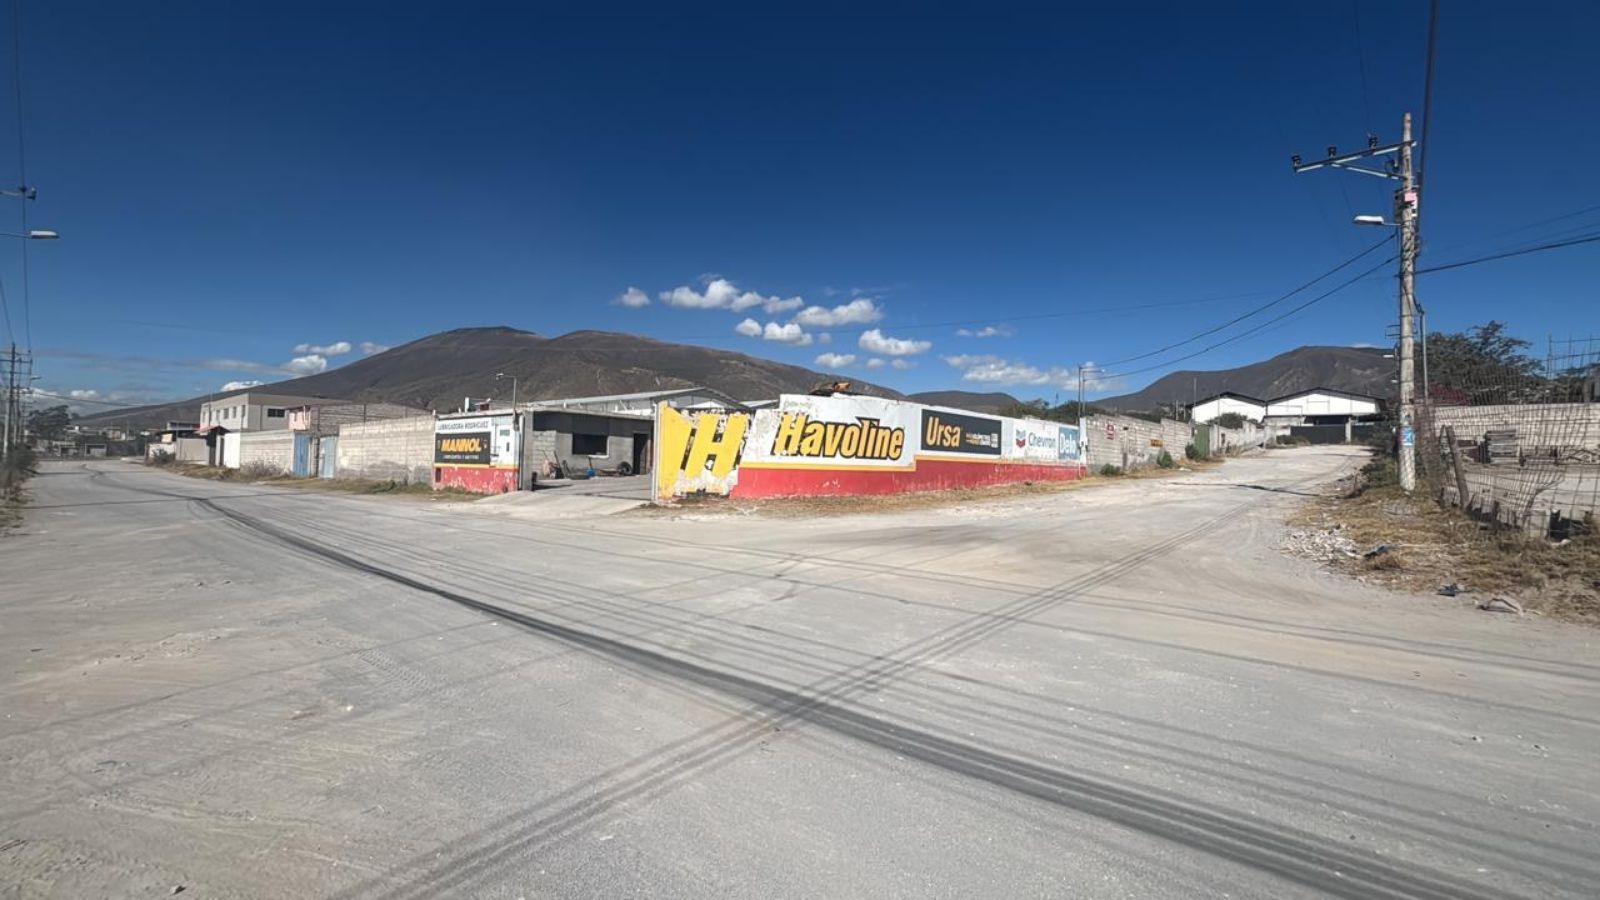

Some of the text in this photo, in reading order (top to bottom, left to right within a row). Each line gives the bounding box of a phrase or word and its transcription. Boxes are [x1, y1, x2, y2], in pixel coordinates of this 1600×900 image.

[771, 413, 905, 461] Havoline
[926, 416, 961, 447] Ursa
[1028, 432, 1056, 448] Chevron
[441, 438, 482, 452] MANNOL
